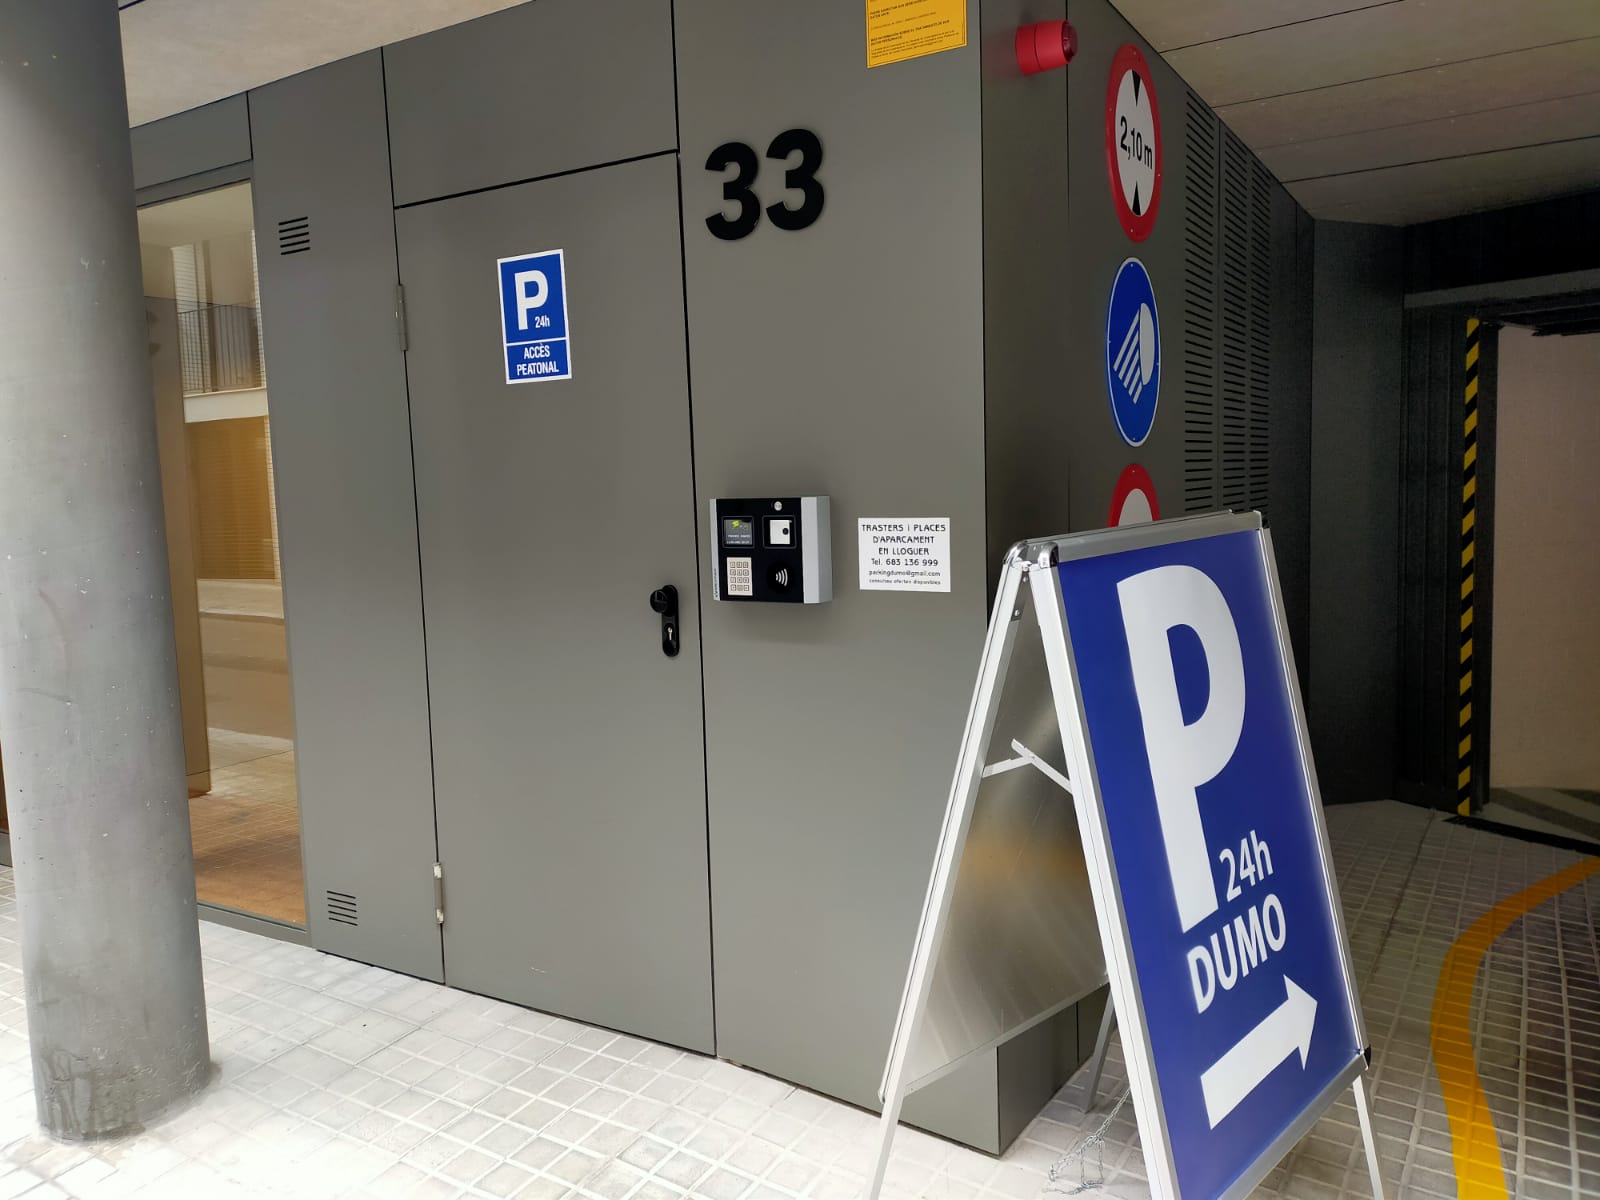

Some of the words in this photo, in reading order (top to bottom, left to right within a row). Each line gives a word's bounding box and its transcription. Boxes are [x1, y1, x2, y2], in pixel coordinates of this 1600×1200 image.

[705, 128, 825, 241] 33
[514, 270, 549, 331] P
[535, 315, 551, 329] 24h
[523, 343, 551, 360] ACCÈS
[517, 361, 560, 376] PEATONAL
[861, 524, 904, 532] TRASTERS
[913, 524, 946, 532] PLACES
[872, 535, 935, 544] D'APARCAMENT
[878, 547, 889, 556] EN
[892, 547, 930, 556] LLOGUER
[885, 558, 901, 566] 683
[922, 558, 939, 567] 999
[1116, 564, 1246, 934] P
[1219, 829, 1275, 903] 24h
[1186, 893, 1288, 1015] DUMO
